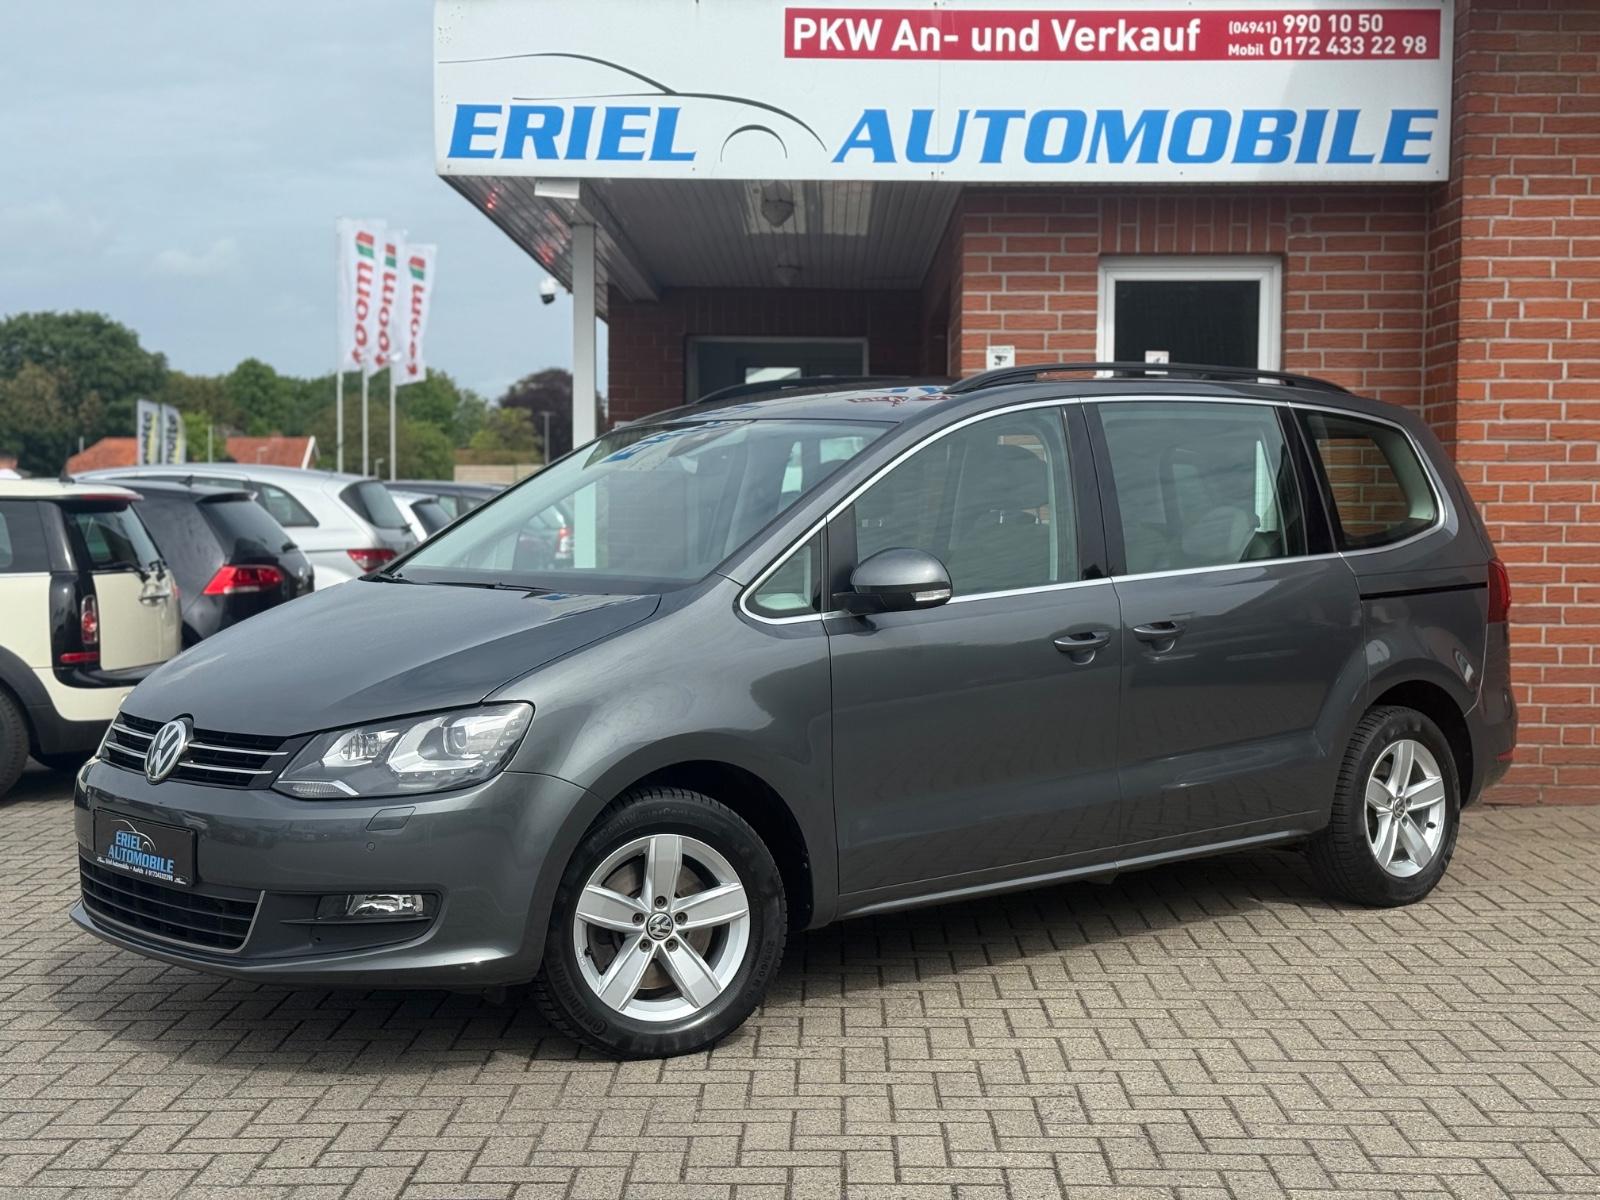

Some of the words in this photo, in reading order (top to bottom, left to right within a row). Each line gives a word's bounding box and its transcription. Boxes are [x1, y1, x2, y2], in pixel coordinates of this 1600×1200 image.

[793, 18, 882, 51] PKW
[891, 19, 959, 52] An-
[971, 19, 1040, 52] und
[1051, 18, 1201, 52] Verkauf
[1228, 20, 1278, 35] (04941)
[1282, 14, 1321, 34] 990
[1327, 14, 1351, 33] 10
[1357, 14, 1383, 33] 50
[1228, 43, 1265, 57] Mobil
[1269, 37, 1320, 56] 0172
[1326, 36, 1365, 55] 433
[1370, 36, 1395, 55] 22
[1402, 36, 1427, 54] 98
[447, 104, 696, 162] ERIEL
[831, 108, 1440, 165] AUTOMOBILE
[115, 831, 142, 851] ERIEL
[108, 844, 175, 874] AUTOMOBILE
